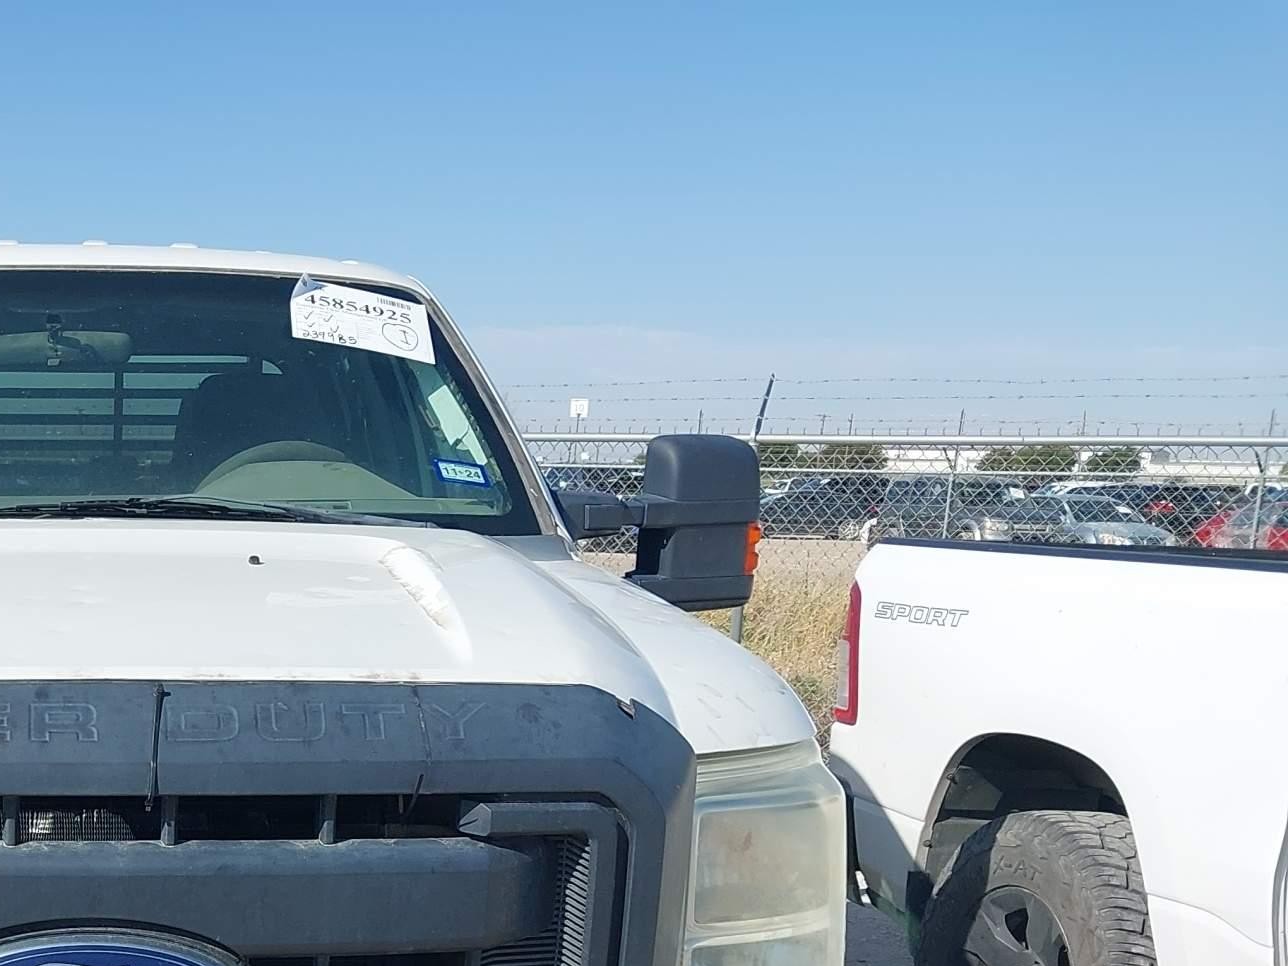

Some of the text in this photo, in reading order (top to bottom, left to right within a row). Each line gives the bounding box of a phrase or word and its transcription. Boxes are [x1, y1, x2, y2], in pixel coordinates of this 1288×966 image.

[305, 294, 412, 324] 45854925
[874, 601, 969, 628] SPORT
[164, 702, 488, 742] DUTY
